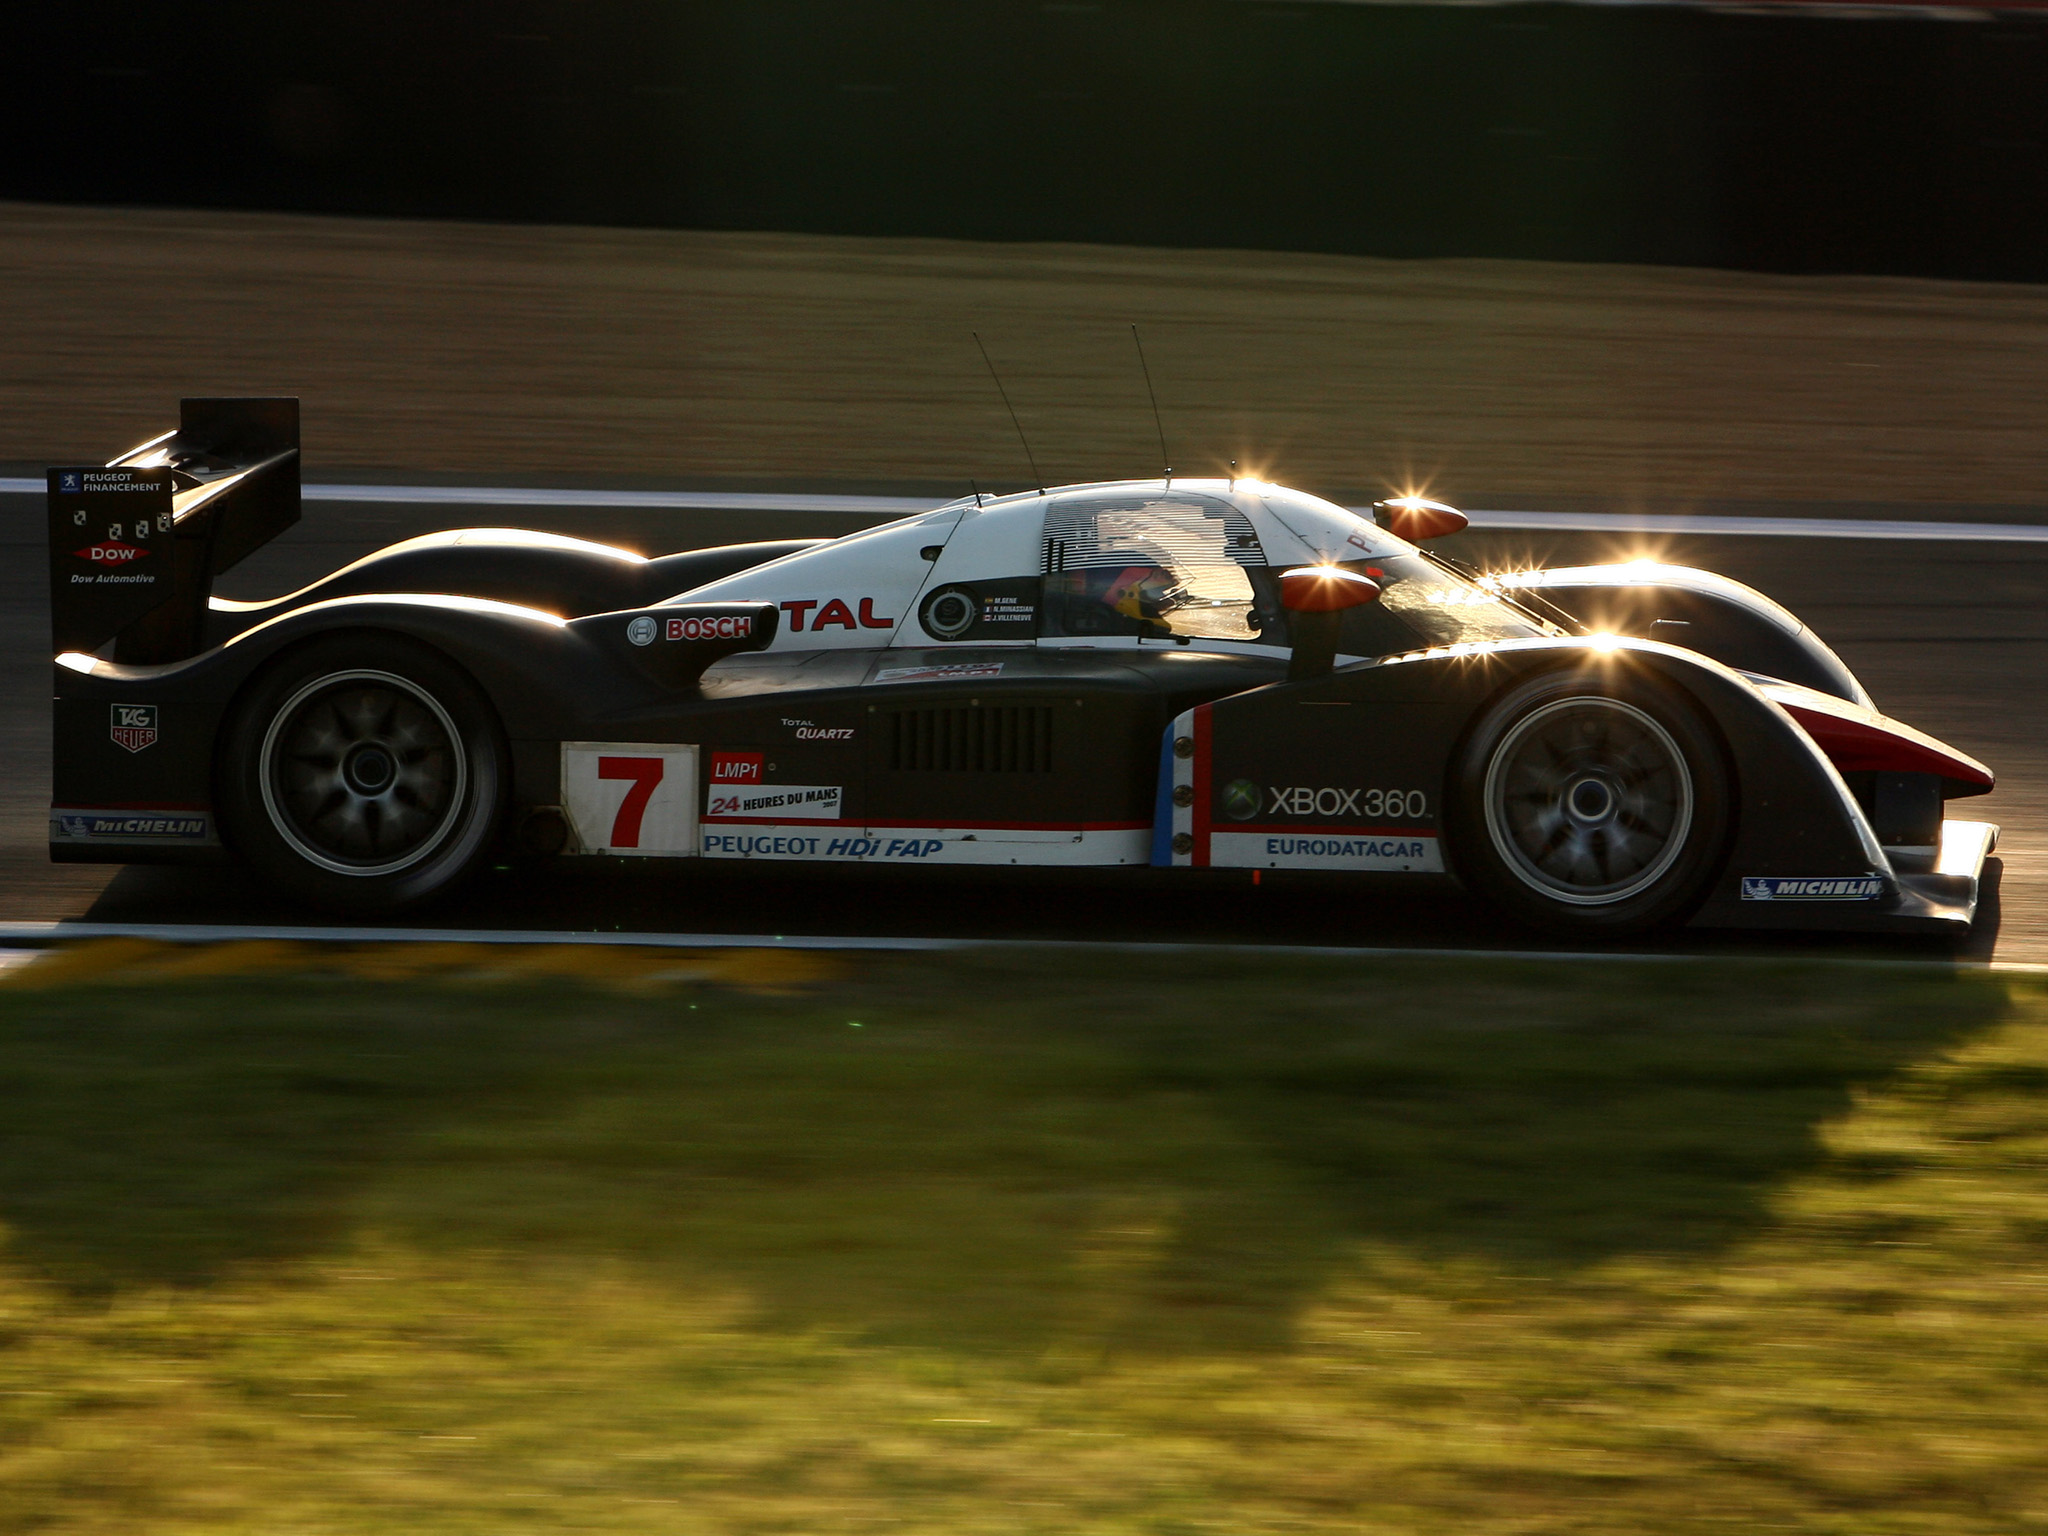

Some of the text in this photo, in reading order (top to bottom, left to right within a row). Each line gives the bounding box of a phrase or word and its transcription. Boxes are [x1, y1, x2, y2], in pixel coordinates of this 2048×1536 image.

[83, 473, 132, 481] PEUGEOT
[83, 483, 161, 492] FINANCEMENT
[70, 574, 156, 583] Dow Automotive
[780, 597, 894, 632] TAL
[667, 618, 750, 639] BOSCH
[119, 708, 150, 727] TAG
[115, 730, 155, 749] HEUER
[795, 727, 855, 740] QUARTZ
[714, 762, 759, 779] LMP1
[598, 756, 664, 848] 7
[709, 788, 838, 815] 24 HEURES DU MANS
[822, 800, 838, 808] 2007
[1268, 786, 1426, 818] XBOX 360
[93, 820, 203, 832] MICHELIN
[704, 835, 821, 855] PEUGEOT
[884, 839, 944, 858] FAP
[1267, 839, 1424, 857] EURODATACAR
[1776, 881, 1881, 894] MICHELIN
